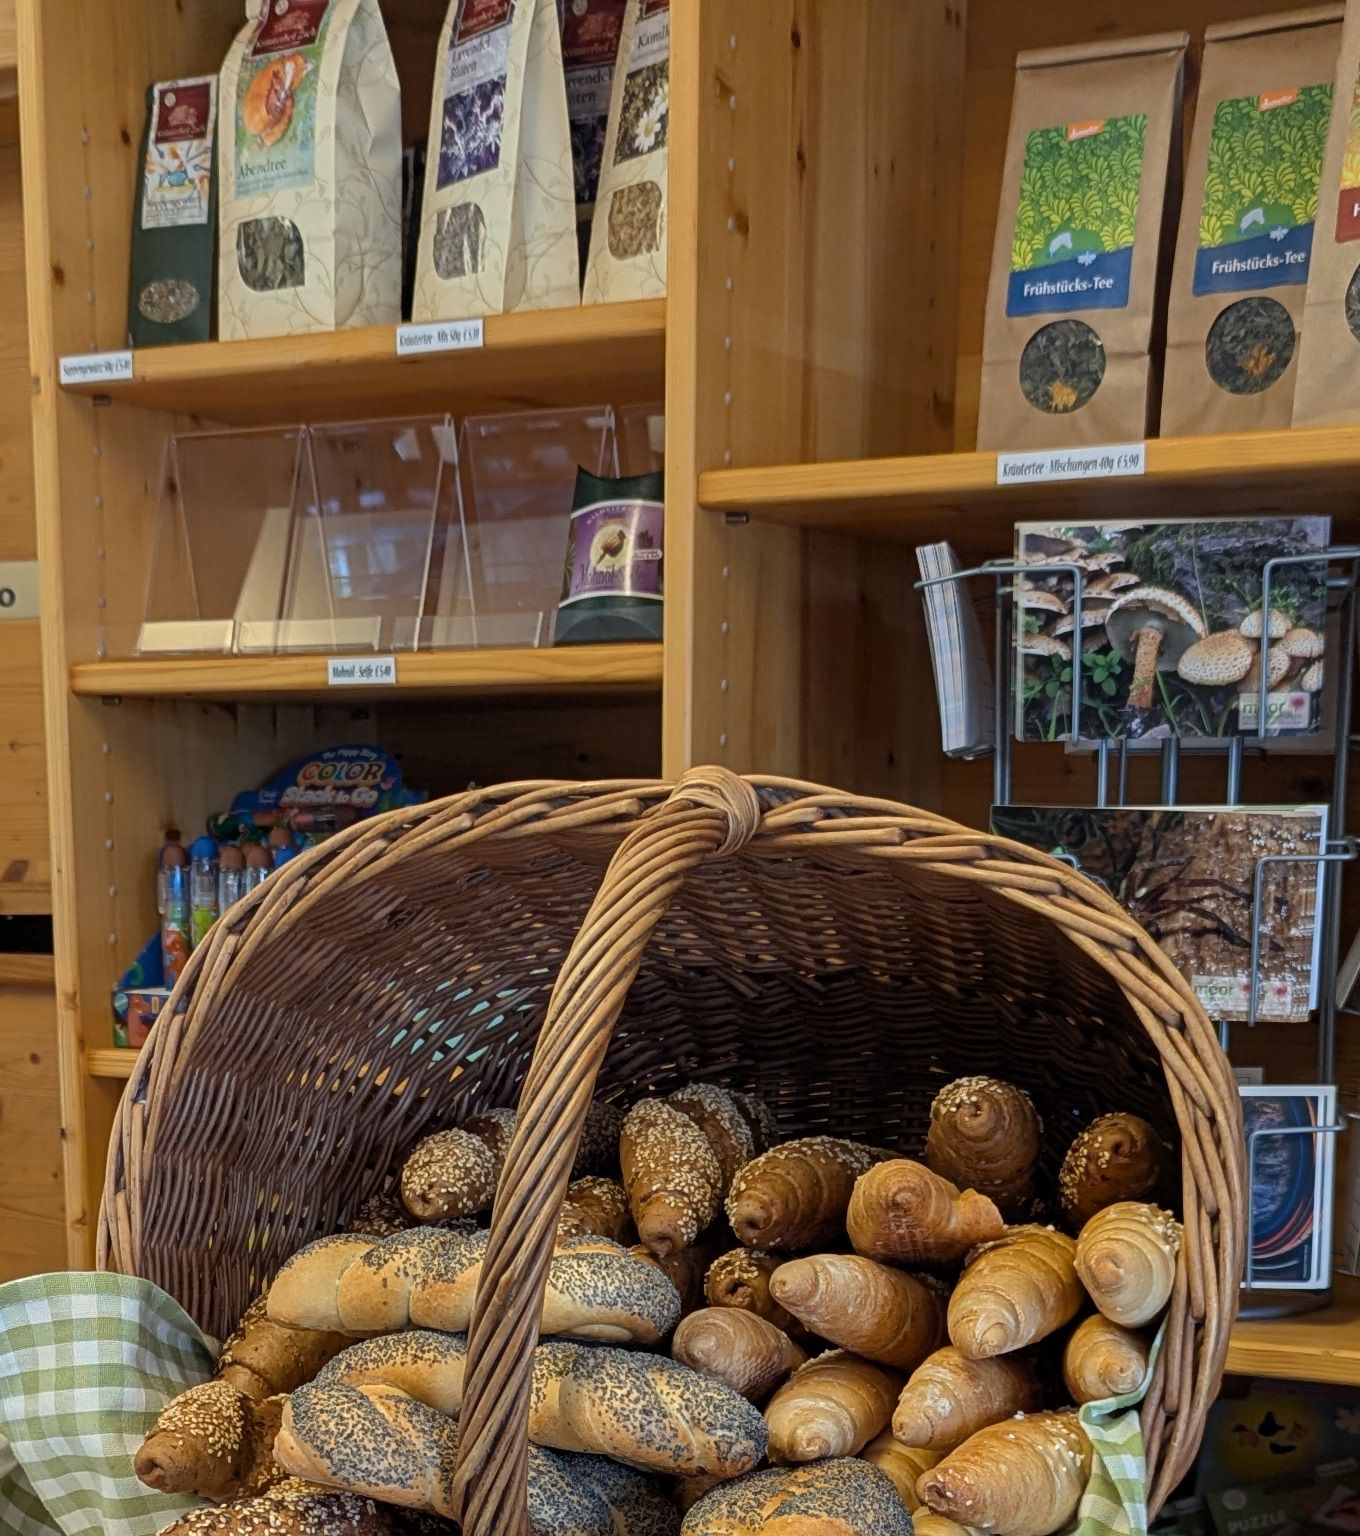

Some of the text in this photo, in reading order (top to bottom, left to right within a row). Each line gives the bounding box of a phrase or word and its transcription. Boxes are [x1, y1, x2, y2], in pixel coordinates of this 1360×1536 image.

[1211, 250, 1306, 275] Frühstücks-Tee
[1023, 276, 1114, 298] Frühstücks-Tee
[1003, 462, 1044, 477] Kräutertee
[1049, 457, 1098, 475] Mischungen
[300, 761, 385, 783] COLOR
